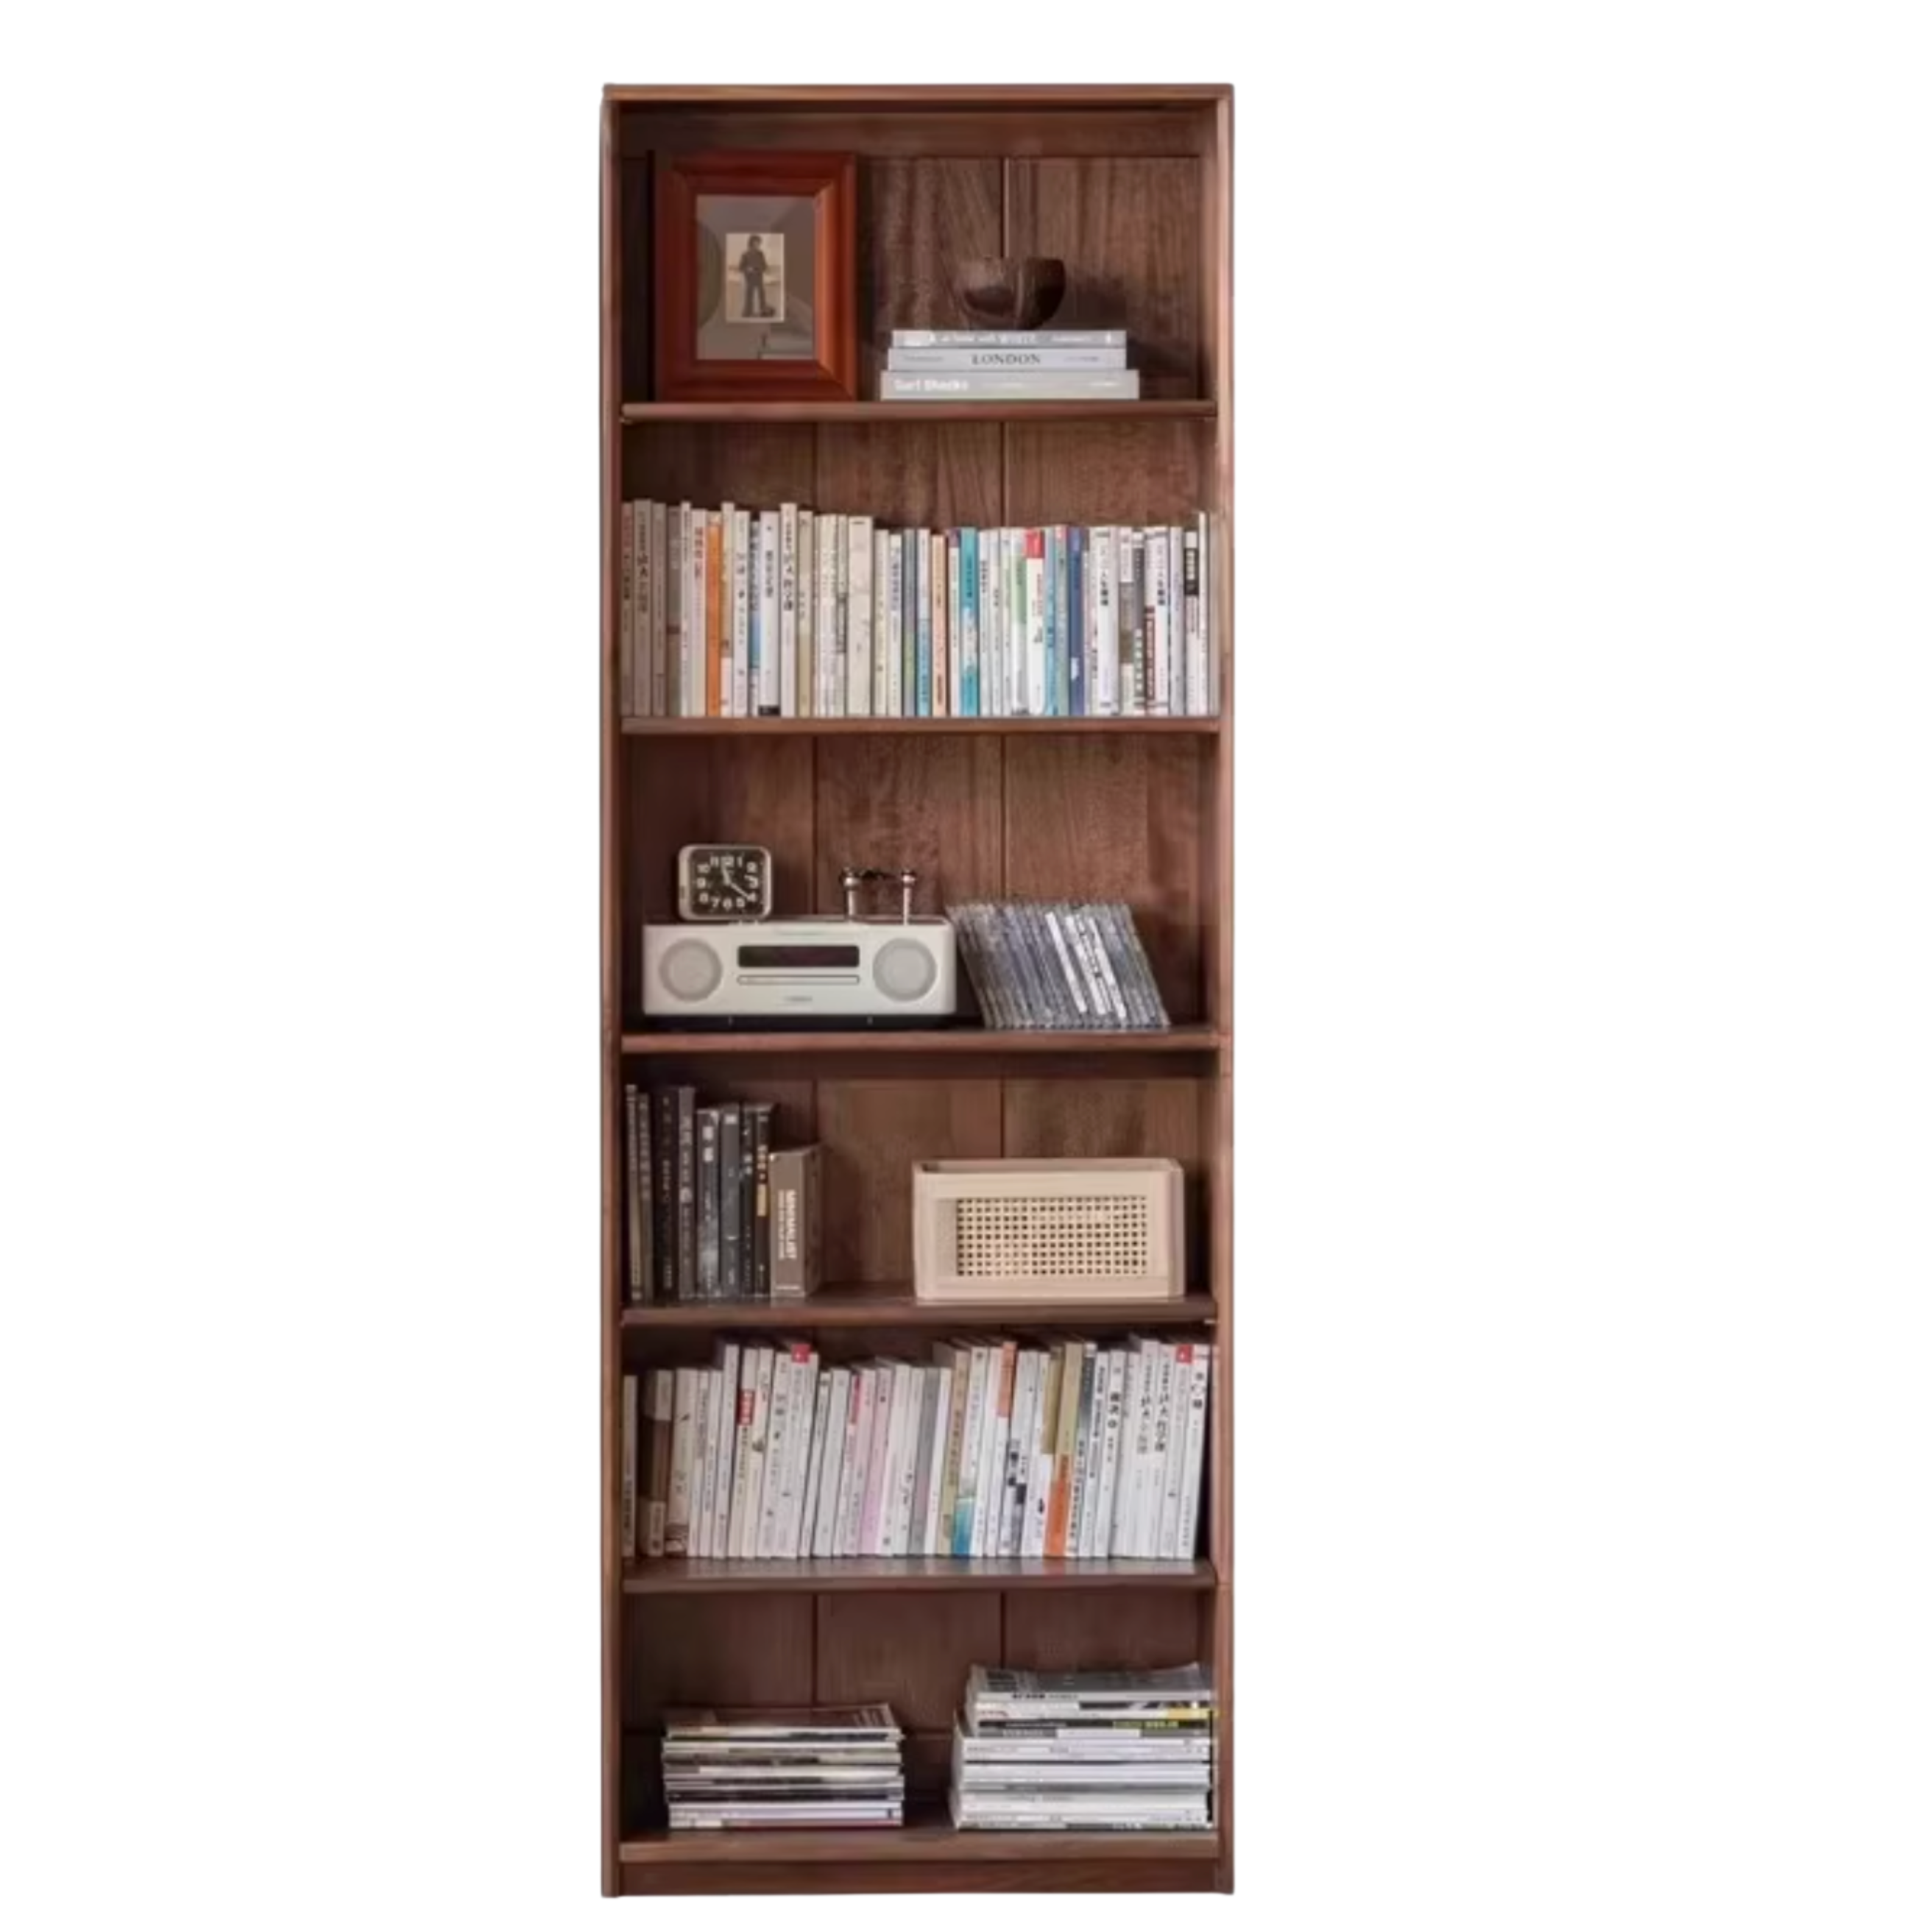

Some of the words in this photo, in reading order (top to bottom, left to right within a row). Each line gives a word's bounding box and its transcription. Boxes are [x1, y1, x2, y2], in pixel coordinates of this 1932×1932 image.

[971, 353, 1041, 366] LONDON
[744, 874, 759, 889] 3
[710, 896, 721, 908] 7
